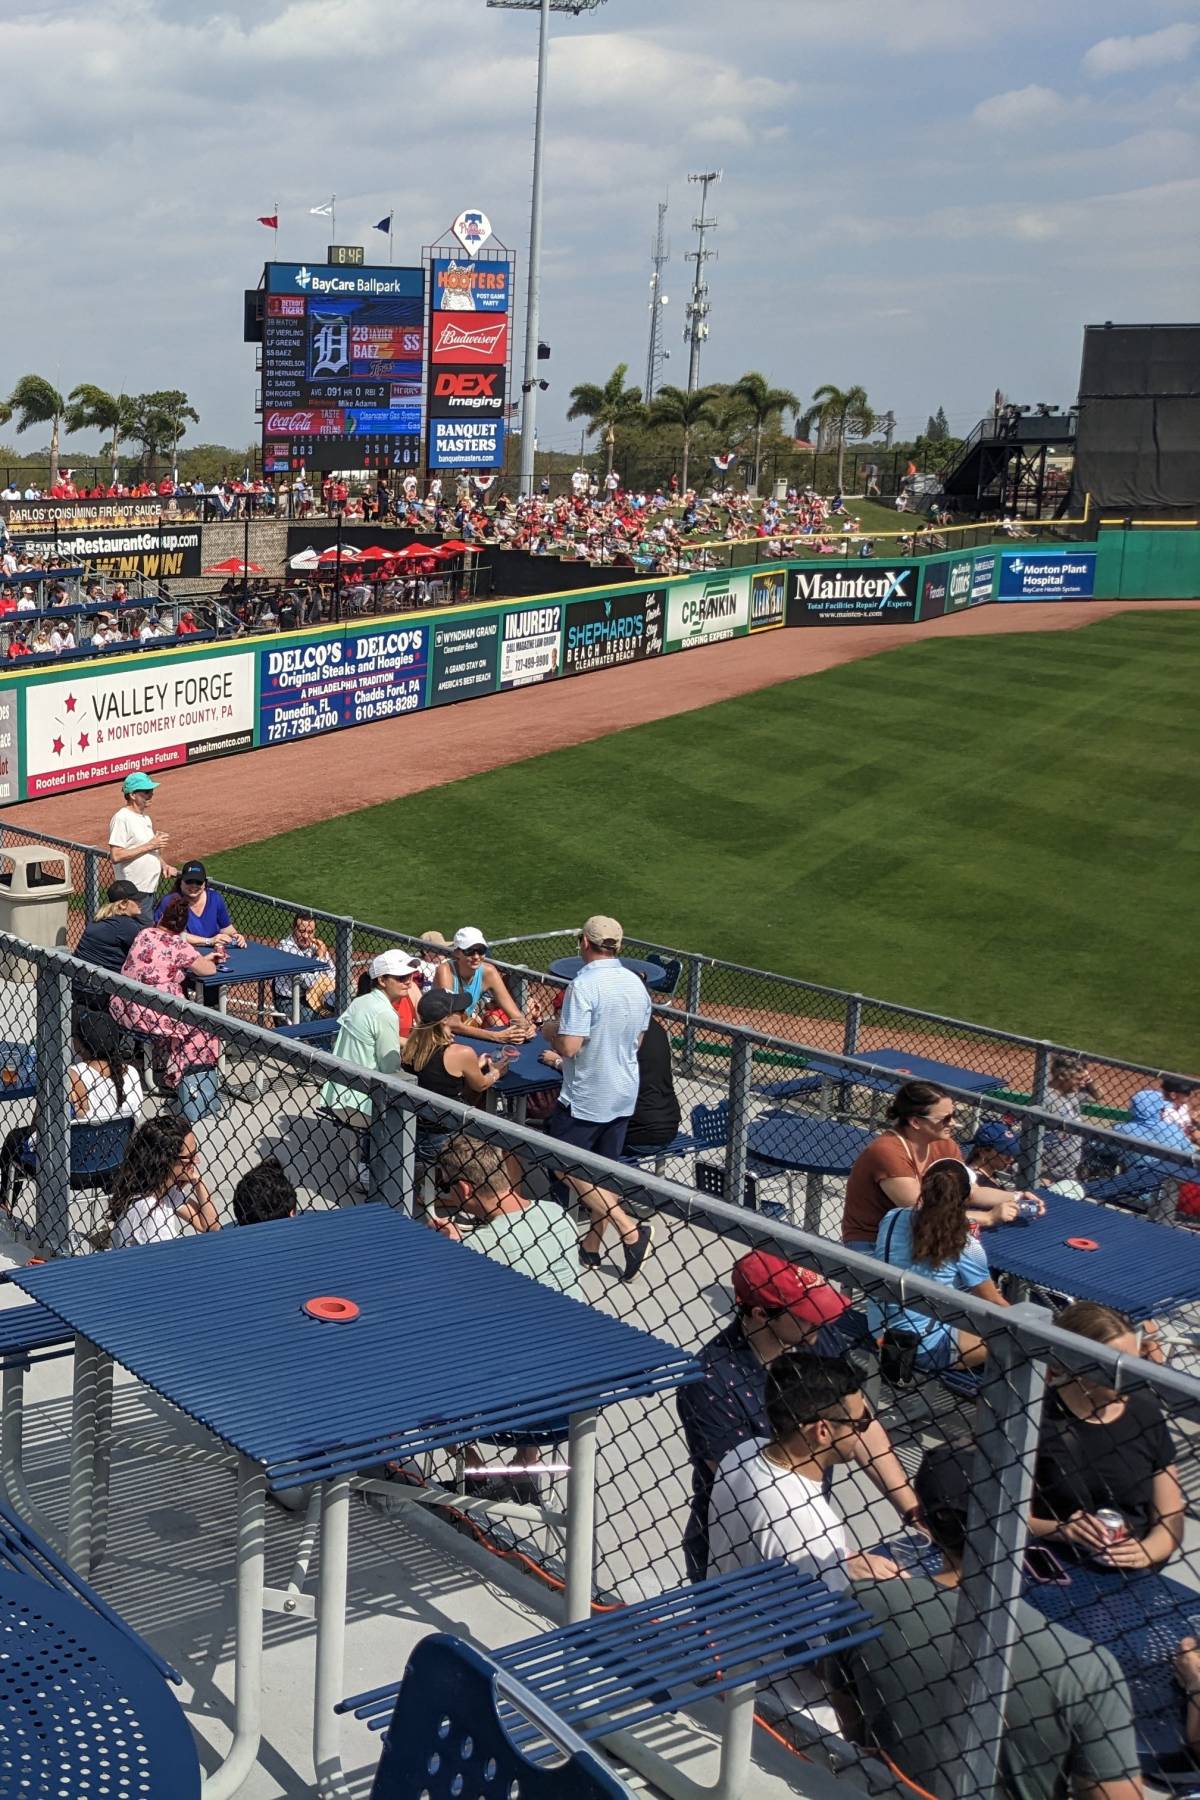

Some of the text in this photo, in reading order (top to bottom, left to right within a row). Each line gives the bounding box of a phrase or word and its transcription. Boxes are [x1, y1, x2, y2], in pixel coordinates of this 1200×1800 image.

[312, 277, 401, 295] BayCare Ballpark
[437, 272, 505, 289] HOOTERS
[281, 299, 305, 307] DETROIT
[281, 306, 305, 315] TIGERS
[276, 329, 304, 337] VIERLING
[351, 326, 369, 342] 28
[441, 329, 497, 345] Budweiser
[403, 333, 420, 351] SS
[353, 344, 380, 359] BAEZ
[310, 388, 322, 396] AVG
[343, 388, 353, 396] HR
[355, 386, 361, 396] 0
[378, 387, 385, 397] 2
[434, 373, 497, 396] DEX
[354, 400, 377, 408] Adams
[448, 395, 502, 408] imaging
[320, 409, 340, 418] TASTE
[389, 411, 400, 421] Gas
[436, 423, 497, 439] BANQUET
[436, 439, 497, 452] MASTERS
[394, 450, 400, 463] 2
[403, 449, 410, 463] 0
[438, 454, 494, 463] banquetmasters.com
[48, 505, 98, 520] CONSUMING
[99, 505, 117, 518] FIRE
[118, 504, 134, 517] HOT
[135, 503, 162, 516] SAUCE
[142, 551, 184, 577] WIN!
[1023, 564, 1088, 574] Morton Plant
[794, 570, 911, 601] MaintenX
[1023, 575, 1064, 587] Hospital
[1022, 586, 1043, 594] BayCare
[807, 599, 913, 610] Total Facilities Repair Experts
[505, 607, 561, 639] INJURED?
[568, 614, 644, 649] SHEPHARD'S
[443, 624, 497, 644] WYNDHAM GRAND
[682, 628, 734, 649] ROOFING EXPERTS
[268, 629, 423, 675] DELCO'S DELCO'S
[443, 641, 479, 655] Clearwater Beach
[567, 634, 643, 662] BEACH RESORT
[449, 659, 487, 674] GRAND STAY ON
[575, 649, 635, 671] CLEARWATER BEACH
[279, 652, 414, 688] Original Steaks and Hoagies
[301, 672, 395, 699] A PHILADELPHIA TRADITION
[438, 672, 492, 691] AMERICA'S BEST BEACH
[92, 672, 233, 722] VALLEY FORGE
[354, 679, 420, 704] Chadds Ford, PA
[268, 694, 419, 740] 727-738-4700 610-558-8289
[275, 697, 331, 723] Dunedin, FL
[96, 704, 233, 744] & MONTGOMERY COUNTY, PA
[188, 735, 251, 757] makeitmontco.com
[36, 749, 180, 790] Rooted in the Past. Leading the Future.
